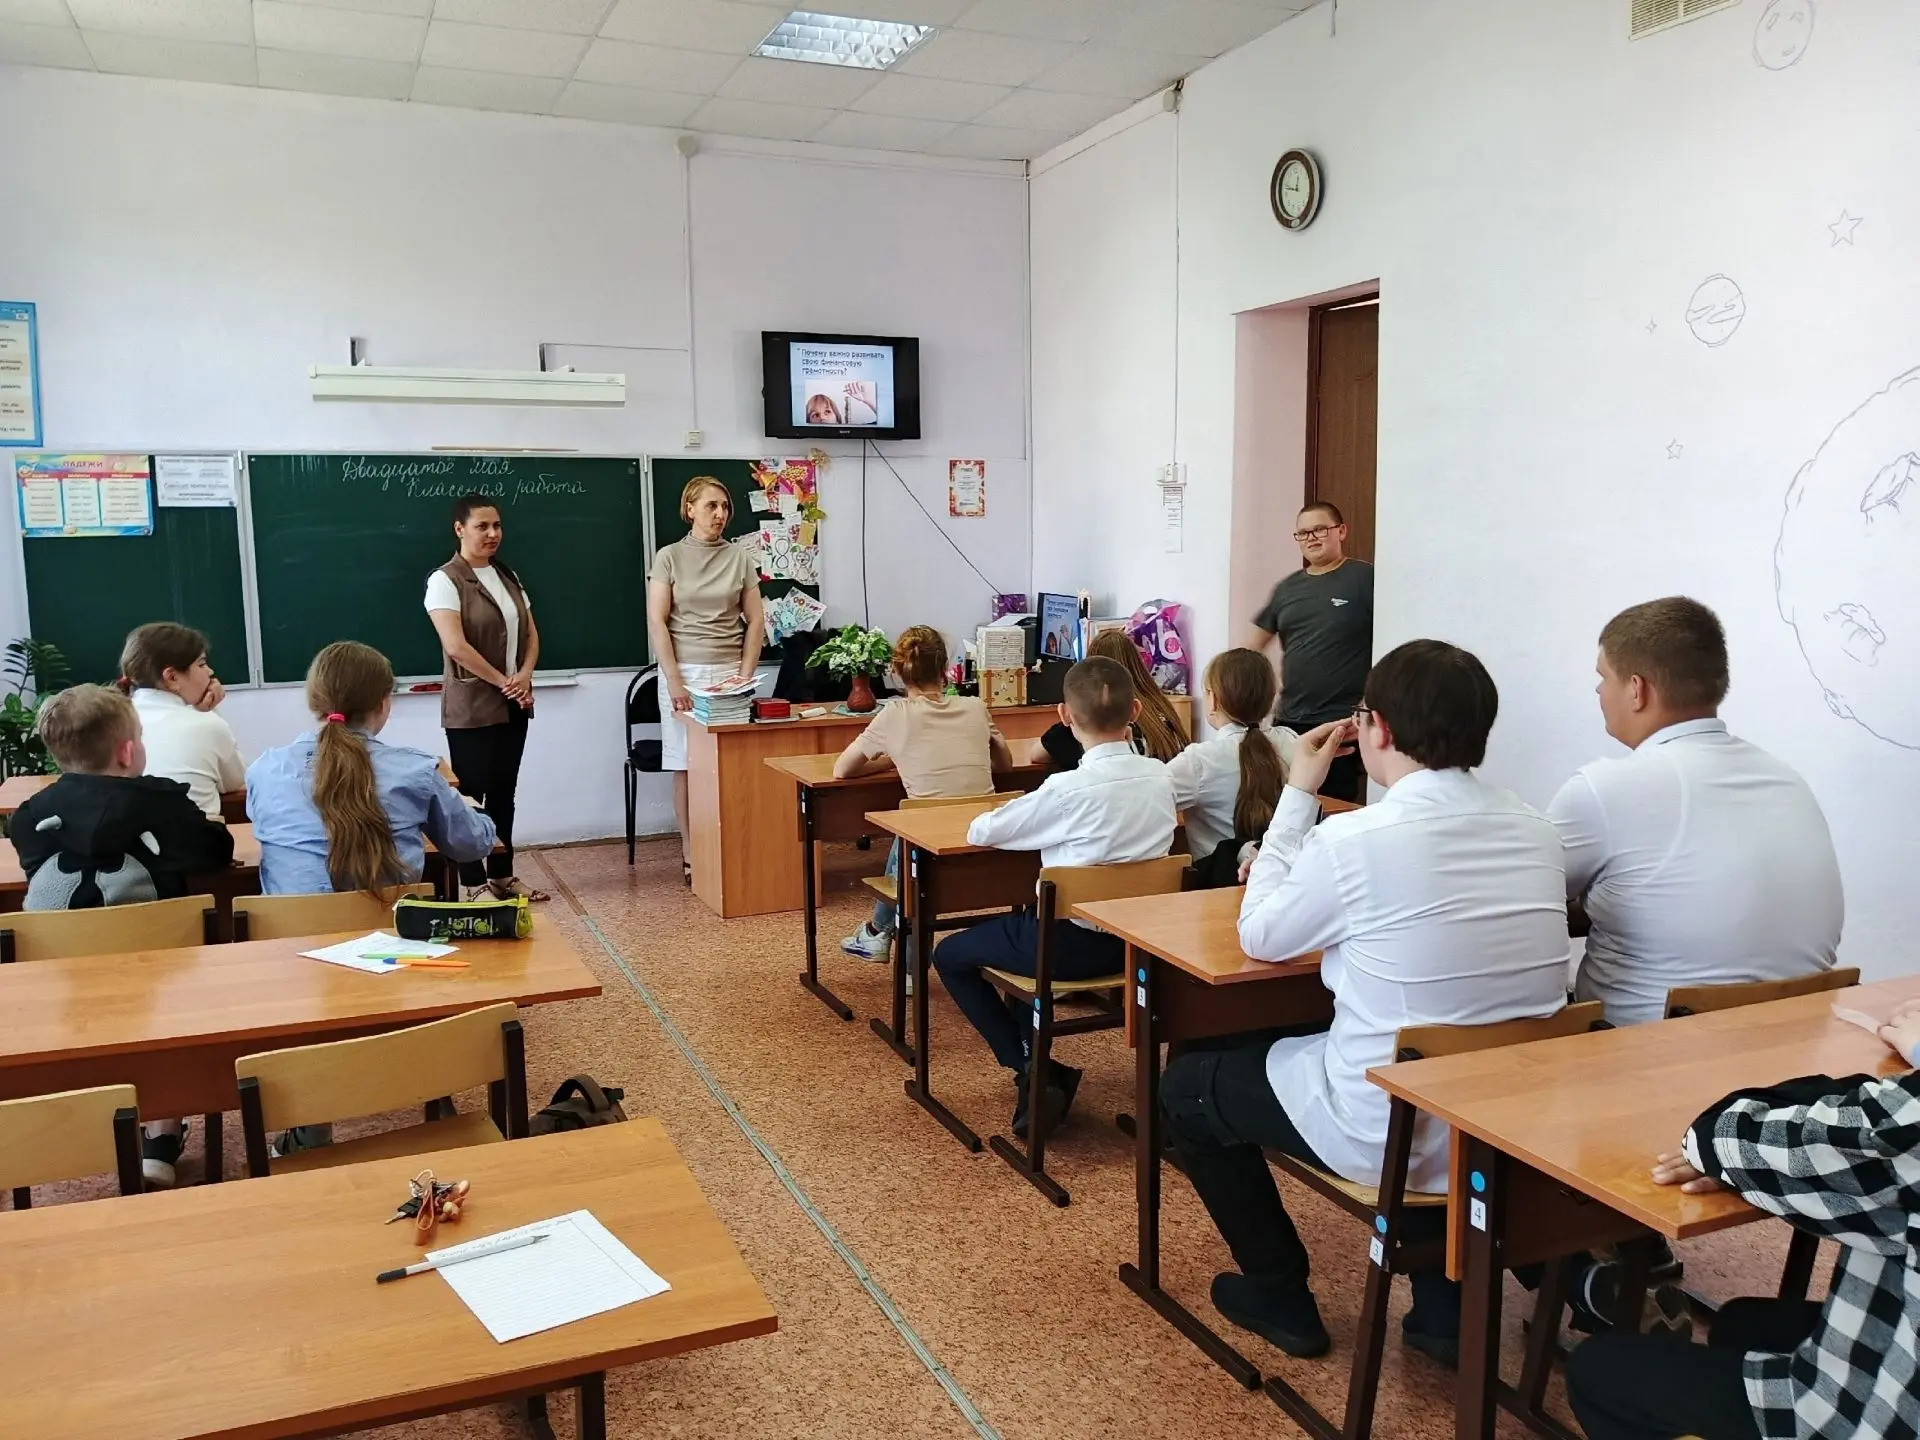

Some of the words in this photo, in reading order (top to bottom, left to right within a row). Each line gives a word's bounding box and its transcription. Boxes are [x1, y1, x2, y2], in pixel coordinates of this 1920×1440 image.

[802, 348, 827, 358] Почему
[852, 351, 885, 359] развивать
[801, 358, 819, 366] свою
[820, 358, 863, 368] финансовую
[801, 367, 848, 376] грамотность?
[342, 456, 455, 491] Двадцатое
[469, 460, 515, 475] мая
[511, 473, 588, 506] работа
[1474, 1207, 1482, 1222] 4
[1373, 1244, 1380, 1257] 3
